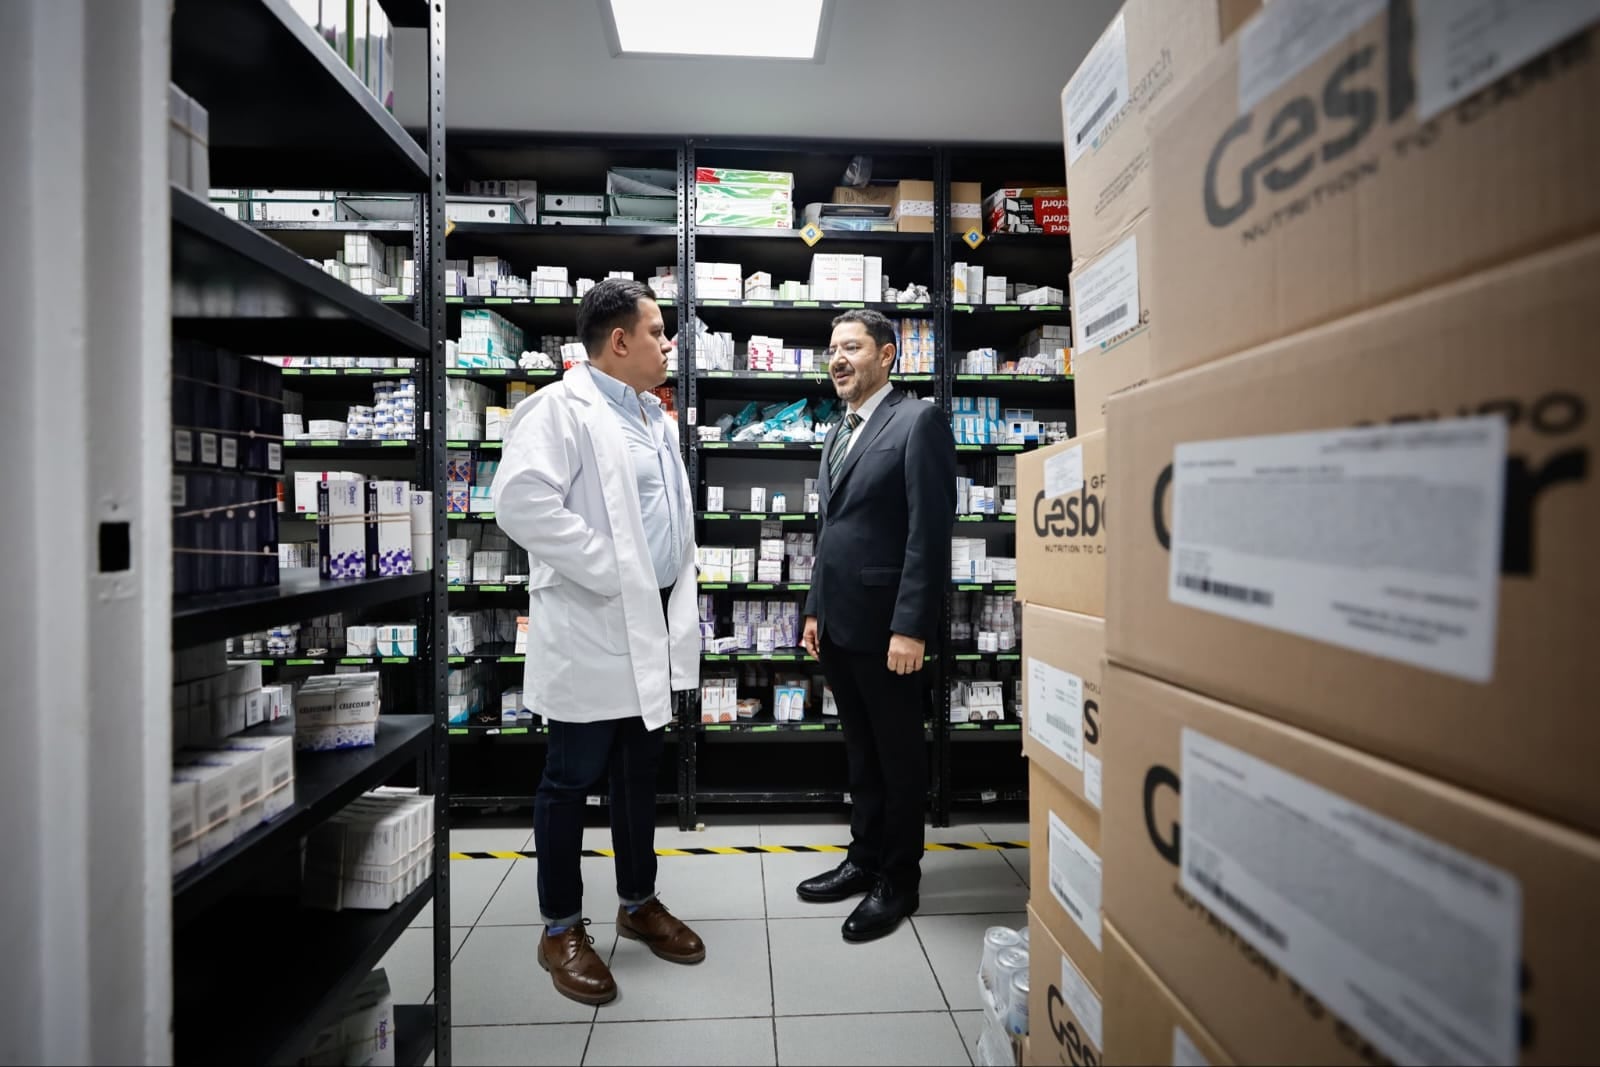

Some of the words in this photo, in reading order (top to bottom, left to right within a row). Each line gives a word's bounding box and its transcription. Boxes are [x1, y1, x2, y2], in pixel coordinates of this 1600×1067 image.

[1033, 479, 1106, 538] Gesb
[1045, 543, 1080, 554] NUTRITION
[1083, 543, 1094, 554] TO
